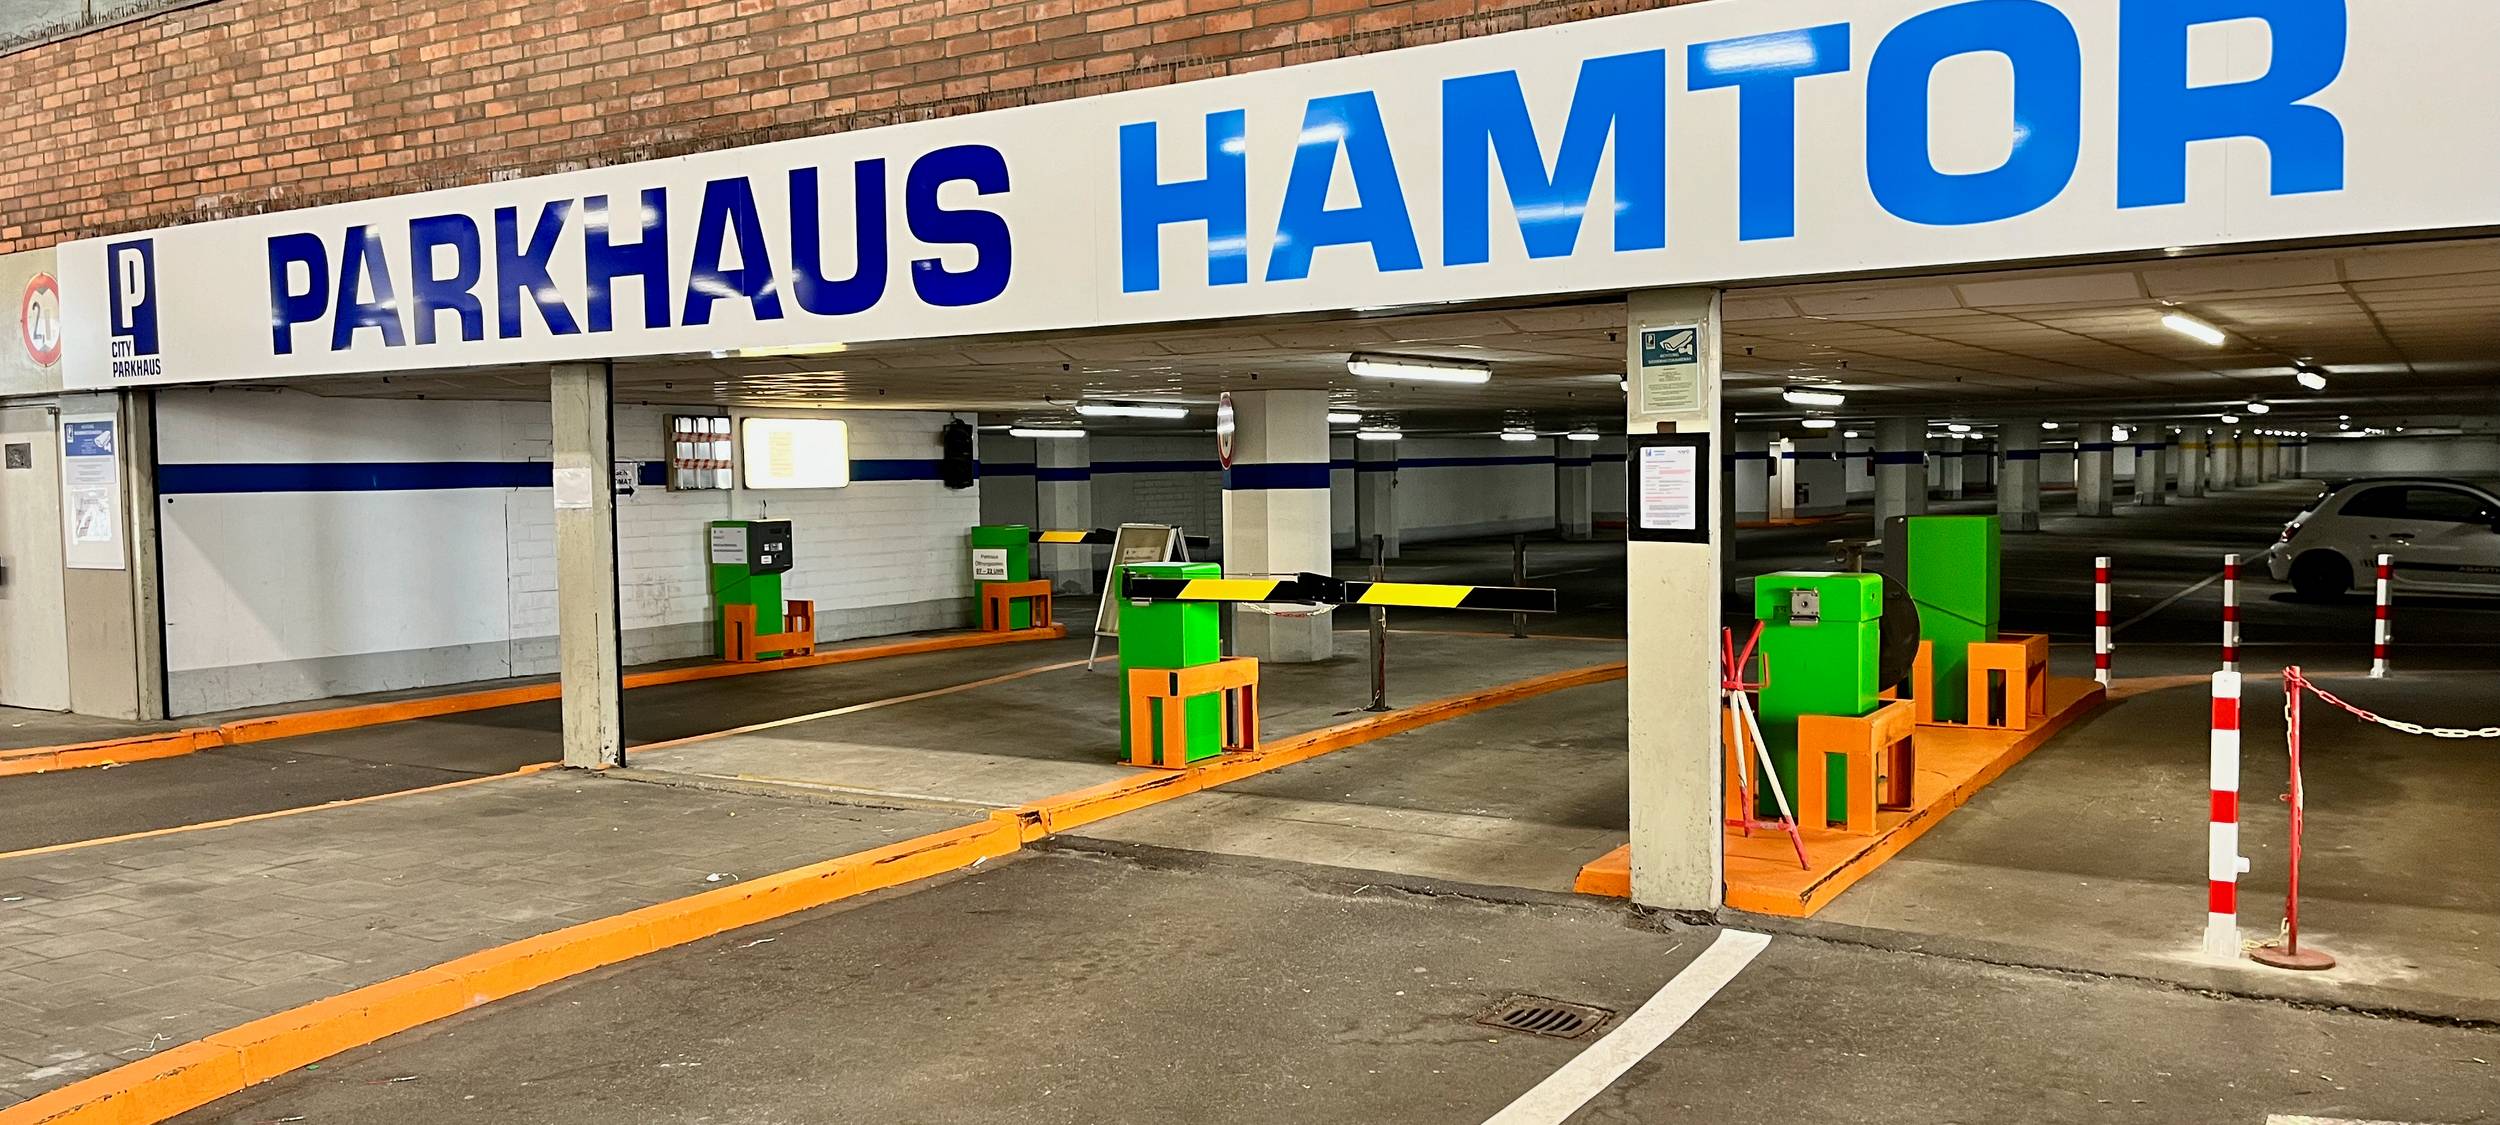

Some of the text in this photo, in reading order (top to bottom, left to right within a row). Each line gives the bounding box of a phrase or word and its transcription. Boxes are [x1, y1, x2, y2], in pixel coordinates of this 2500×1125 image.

[267, 0, 2347, 356] PARKHAUS HAMTOR
[119, 248, 145, 328] P
[112, 340, 131, 357] CITY
[113, 359, 161, 377] PARKHAUS
